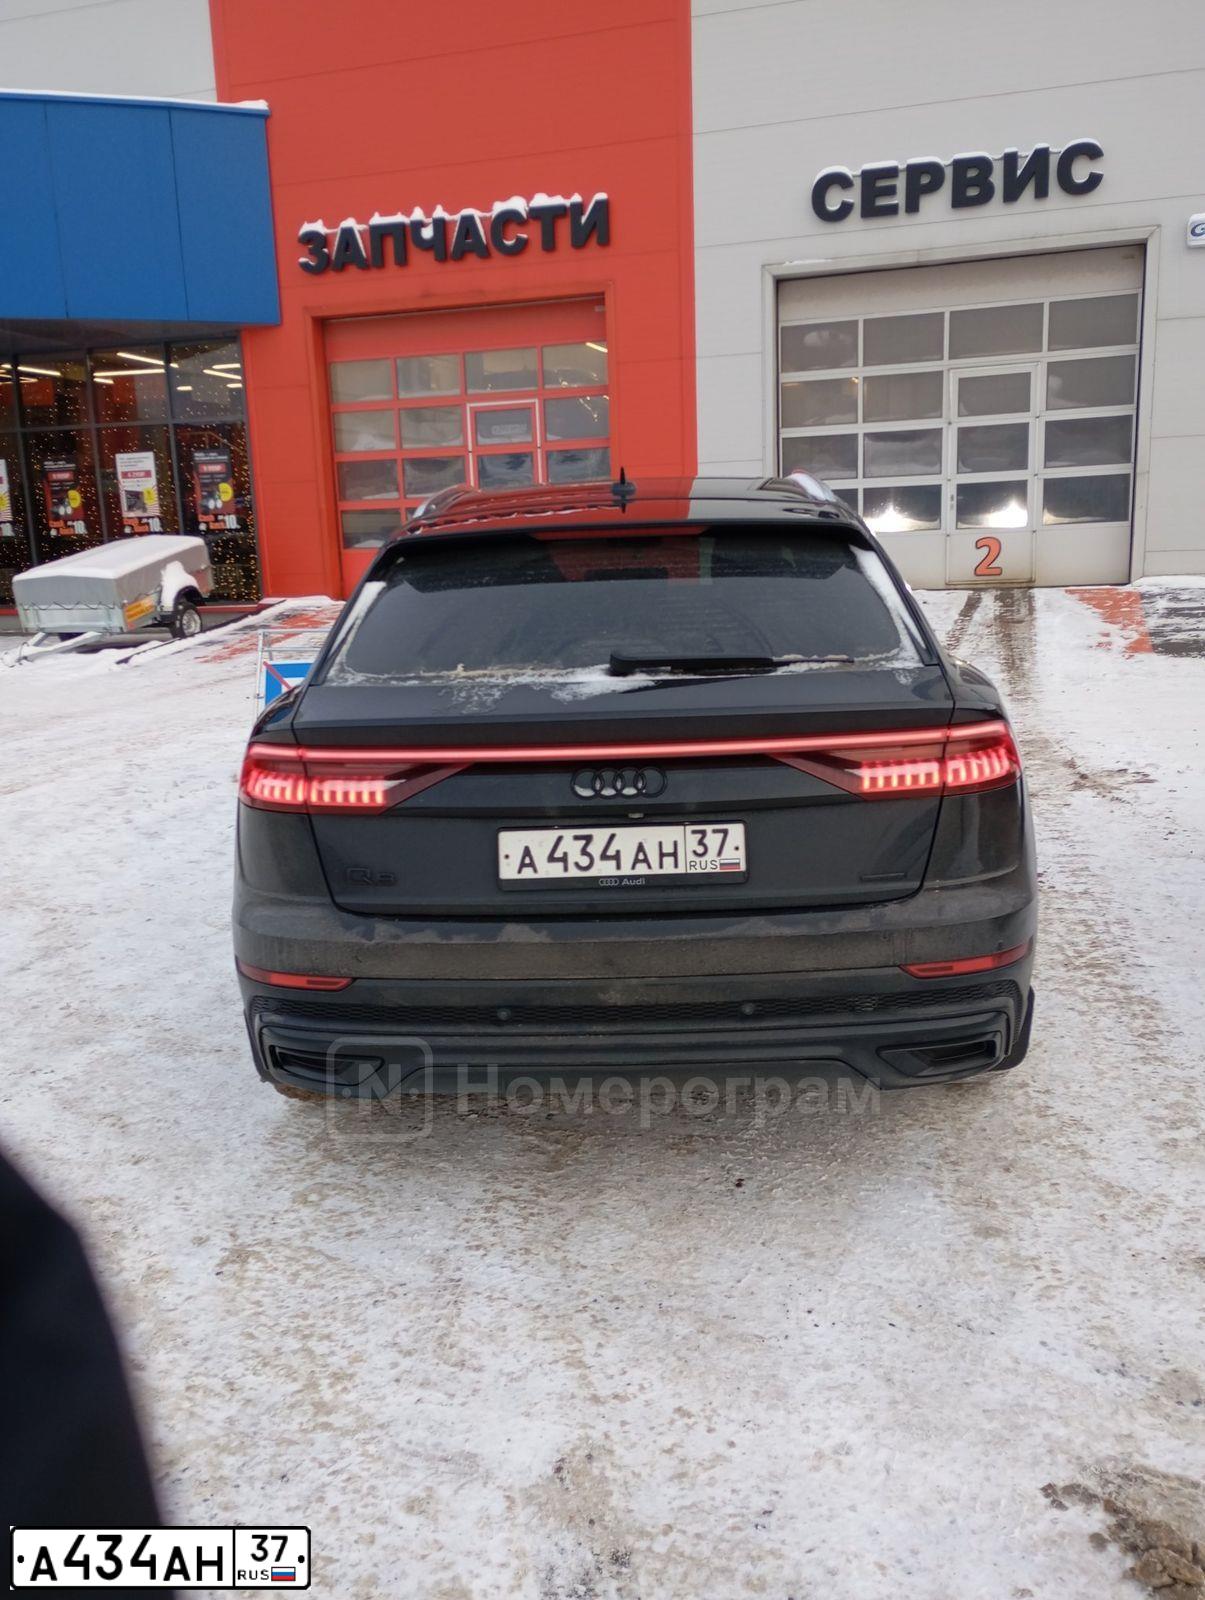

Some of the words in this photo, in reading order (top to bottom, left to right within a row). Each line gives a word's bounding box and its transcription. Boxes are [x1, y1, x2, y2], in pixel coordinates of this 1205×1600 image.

[811, 139, 1104, 222] СЕРВИС
[298, 195, 610, 275] ЗАПЧАСТИ
[974, 536, 1002, 576] 2
[691, 828, 730, 858] 37
[621, 877, 646, 886] Audi
[689, 860, 718, 871] RUS
